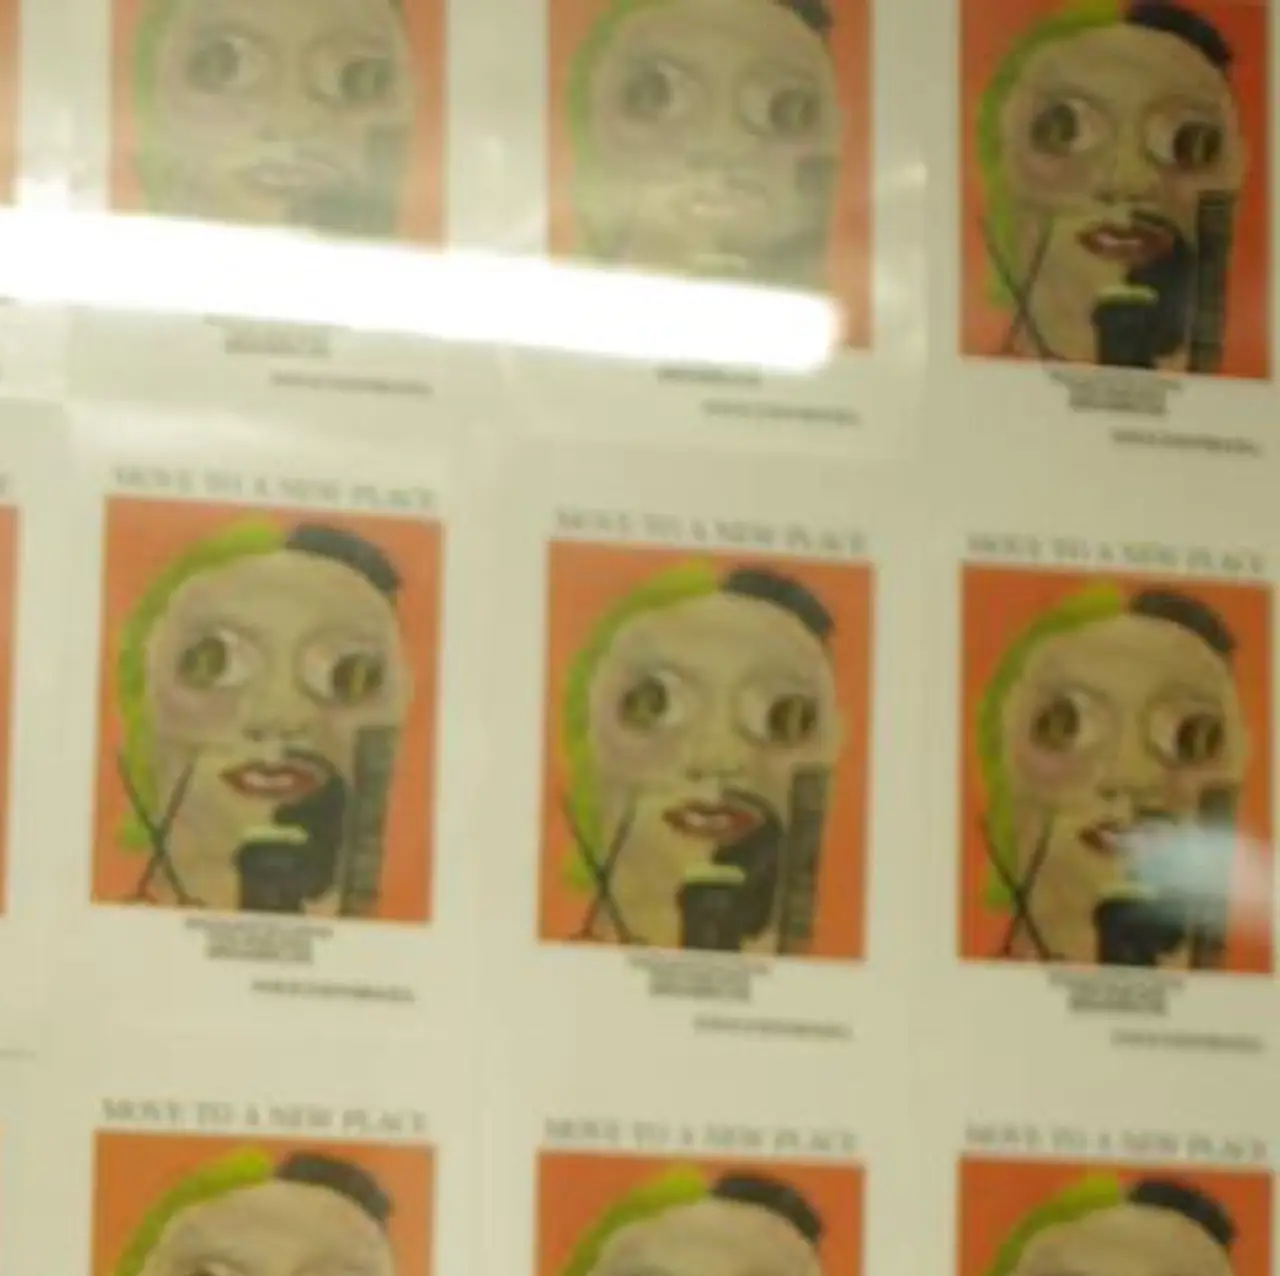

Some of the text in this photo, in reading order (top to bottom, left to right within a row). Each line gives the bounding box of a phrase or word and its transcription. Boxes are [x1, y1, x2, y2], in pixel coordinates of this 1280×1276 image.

[352, 484, 436, 511] PLACE
[642, 512, 681, 541] TO
[101, 1097, 180, 1125] MOVE
[197, 1101, 236, 1128] TO
[269, 1105, 333, 1131] NEW
[341, 1107, 428, 1135] PLACE
[633, 1119, 670, 1149] TO
